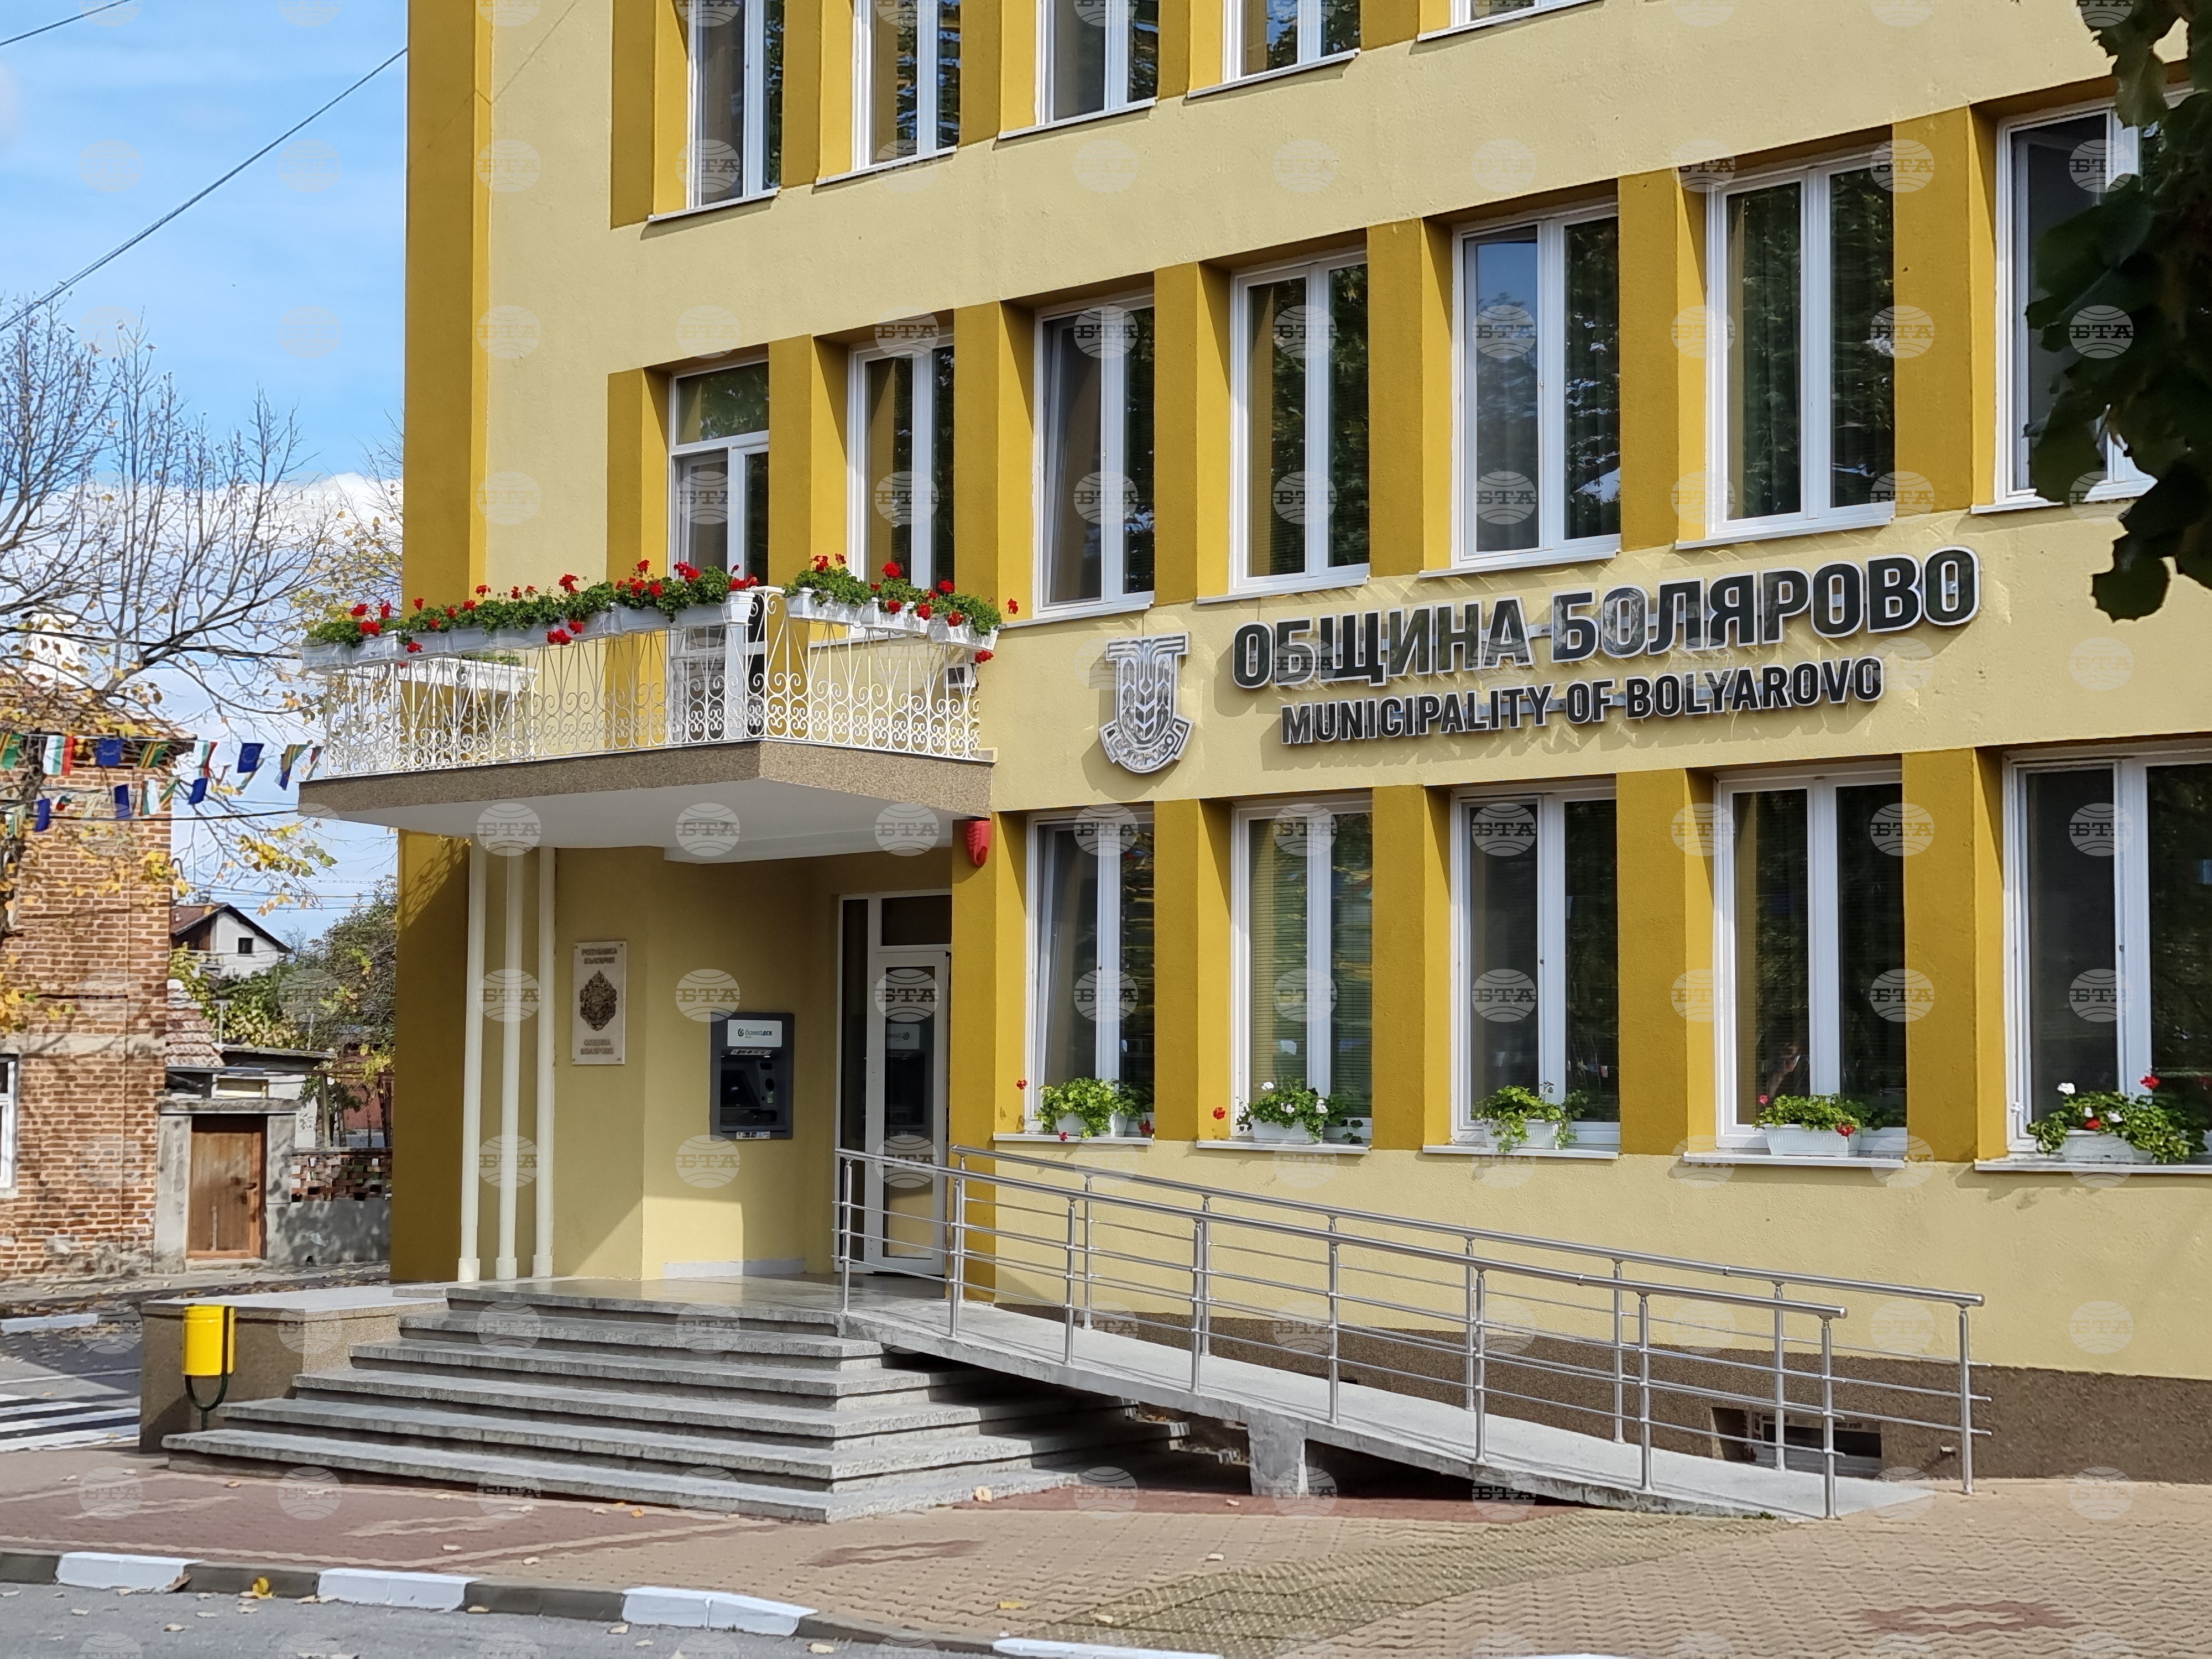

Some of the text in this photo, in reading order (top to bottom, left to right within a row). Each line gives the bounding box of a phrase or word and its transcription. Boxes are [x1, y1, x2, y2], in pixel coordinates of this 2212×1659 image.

[1232, 547, 1980, 688] ОБЩИНА БОЛЯРОВО
[1281, 656, 1884, 745] MUNICIPALITY OF BOLYAROVO
